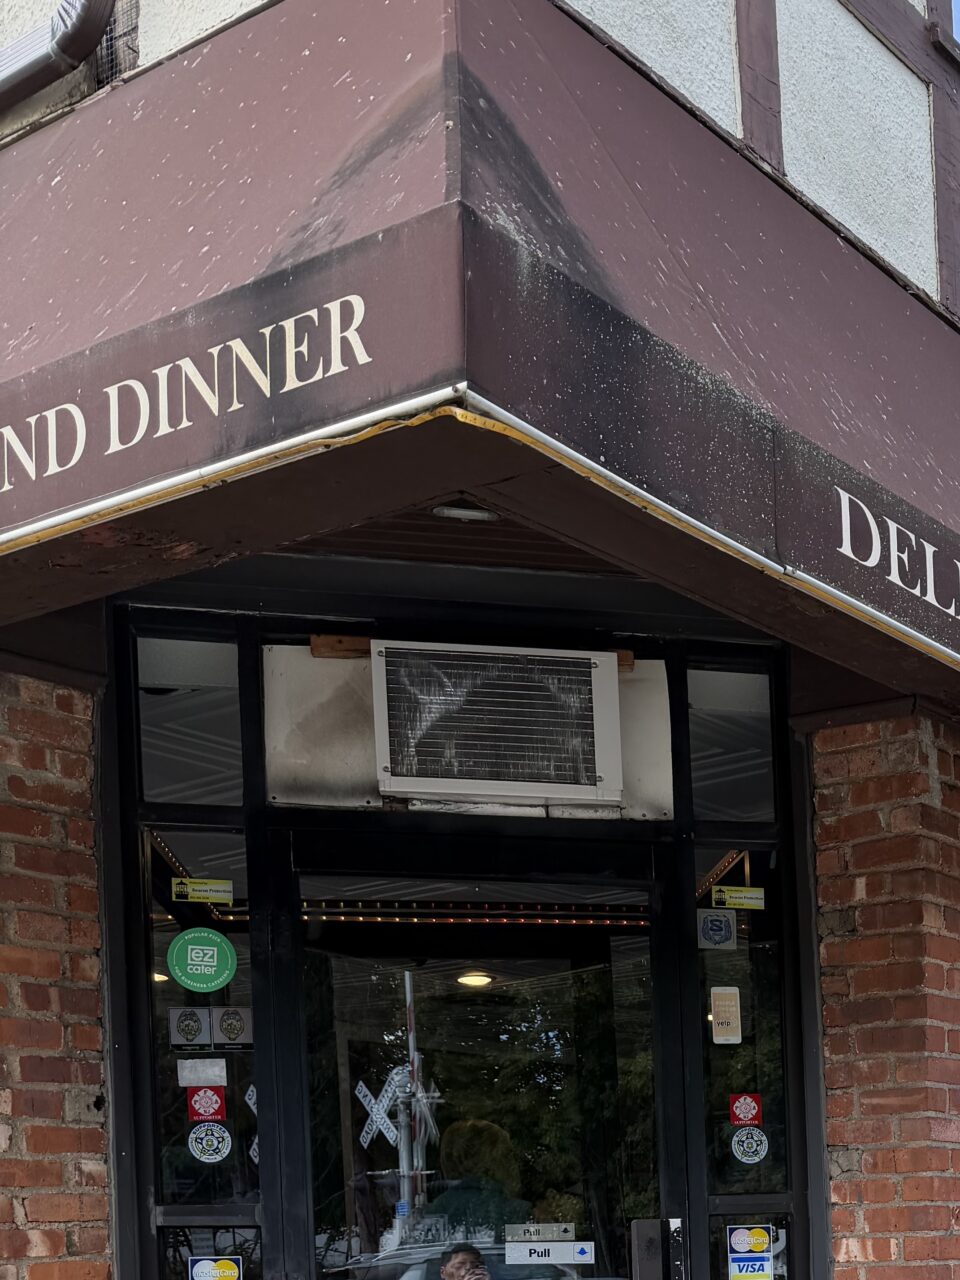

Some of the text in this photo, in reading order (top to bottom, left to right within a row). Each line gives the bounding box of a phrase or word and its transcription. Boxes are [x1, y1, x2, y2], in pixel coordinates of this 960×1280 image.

[0, 294, 373, 493] ND DINNER
[185, 932, 221, 943] POPULAR PICK
[191, 949, 214, 962] ez
[187, 964, 217, 975] cater
[192, 1123, 227, 1135] SUPPORTER
[736, 1127, 764, 1138] SUPPORTER
[523, 1228, 541, 1237] Pull
[528, 1248, 551, 1258] Pull
[737, 1263, 765, 1273] VISA
